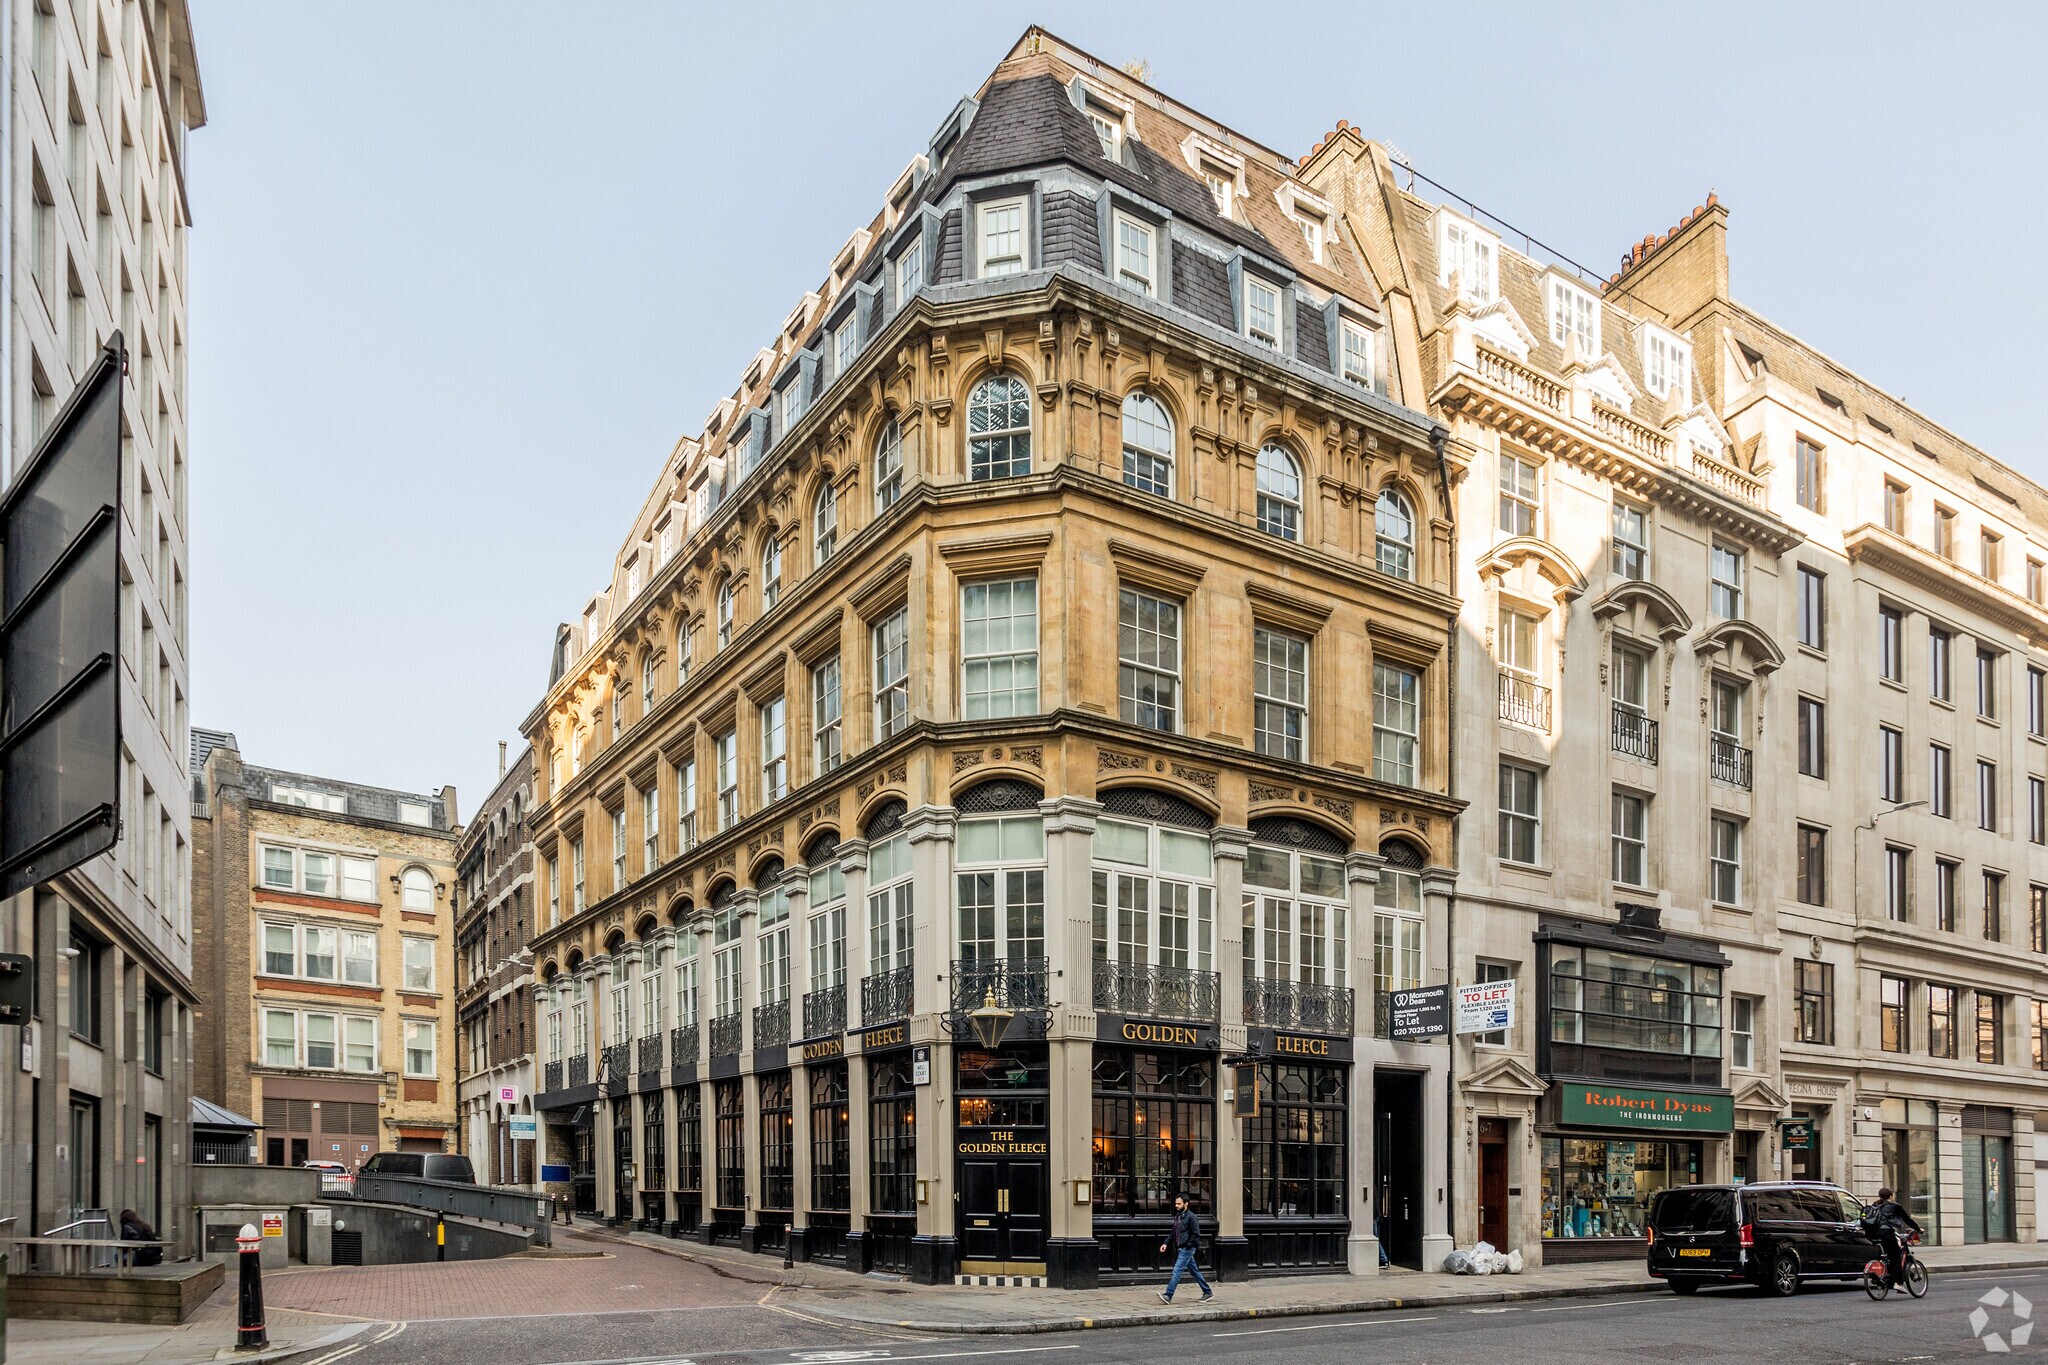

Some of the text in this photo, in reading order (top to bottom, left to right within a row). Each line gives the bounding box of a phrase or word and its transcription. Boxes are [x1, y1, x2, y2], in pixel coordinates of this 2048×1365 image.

[1409, 989, 1444, 998] Monmouth
[1460, 986, 1482, 994] FITTED
[1464, 989, 1507, 1002] TO LET
[1407, 1017, 1419, 1025] Let
[1122, 1023, 1197, 1044] GOLDEN
[1426, 1024, 1443, 1032] 1390
[866, 1027, 903, 1048] FLEECE
[804, 1040, 843, 1059] GOLDEN
[1276, 1036, 1328, 1055] FLEECE
[1789, 1083, 1838, 1096] REGINA HOUSE
[1585, 1092, 1712, 1114] Robert Dyas
[1620, 1111, 1682, 1122] THE IRONMONGERS
[991, 1131, 1014, 1140] THE
[959, 1143, 1046, 1153] GOLDEN FLEECE
